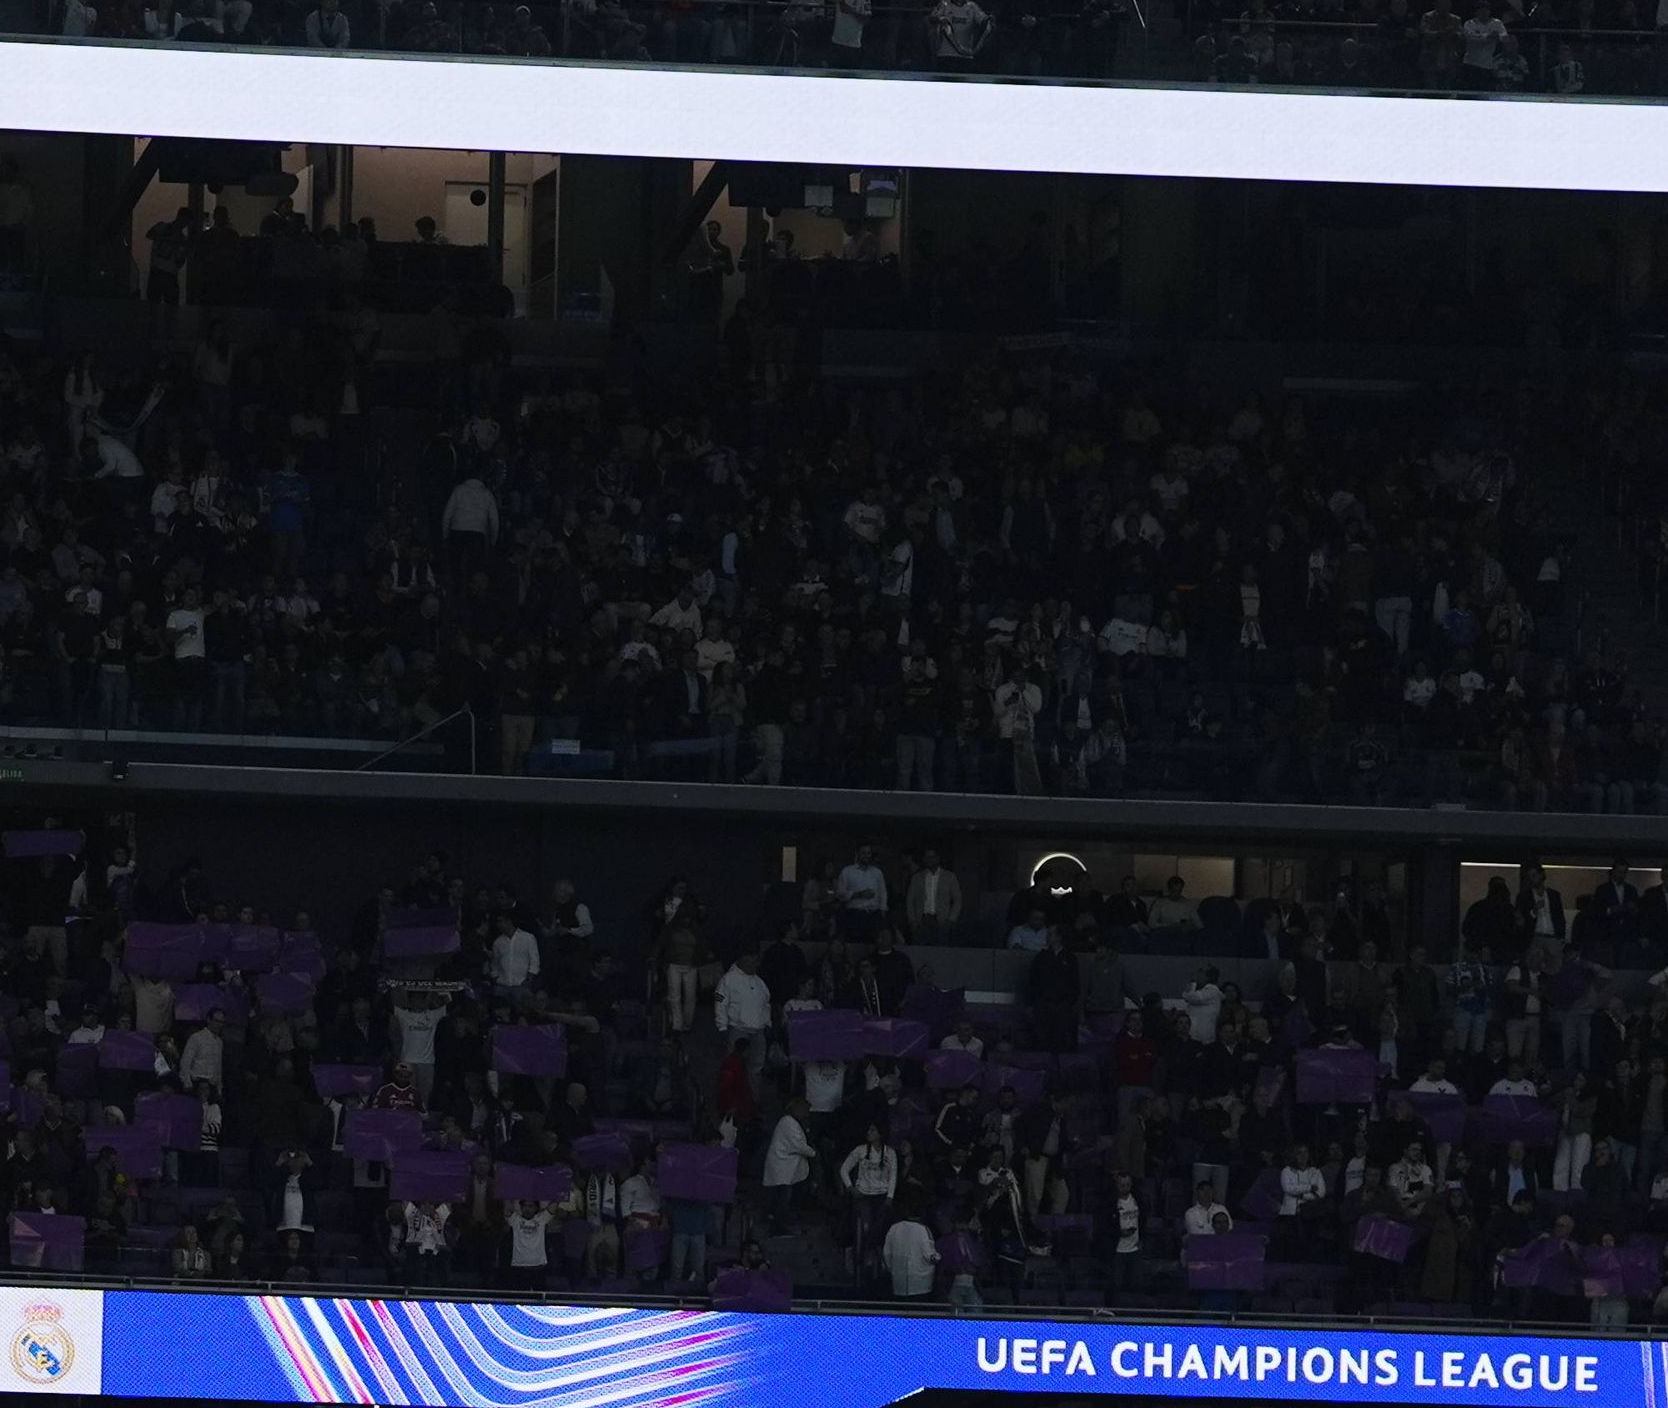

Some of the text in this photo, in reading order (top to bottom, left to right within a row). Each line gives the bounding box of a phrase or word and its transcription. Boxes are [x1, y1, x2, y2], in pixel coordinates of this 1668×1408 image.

[976, 1337, 1599, 1392] UEFA CHAMPIONS LEAGUE
